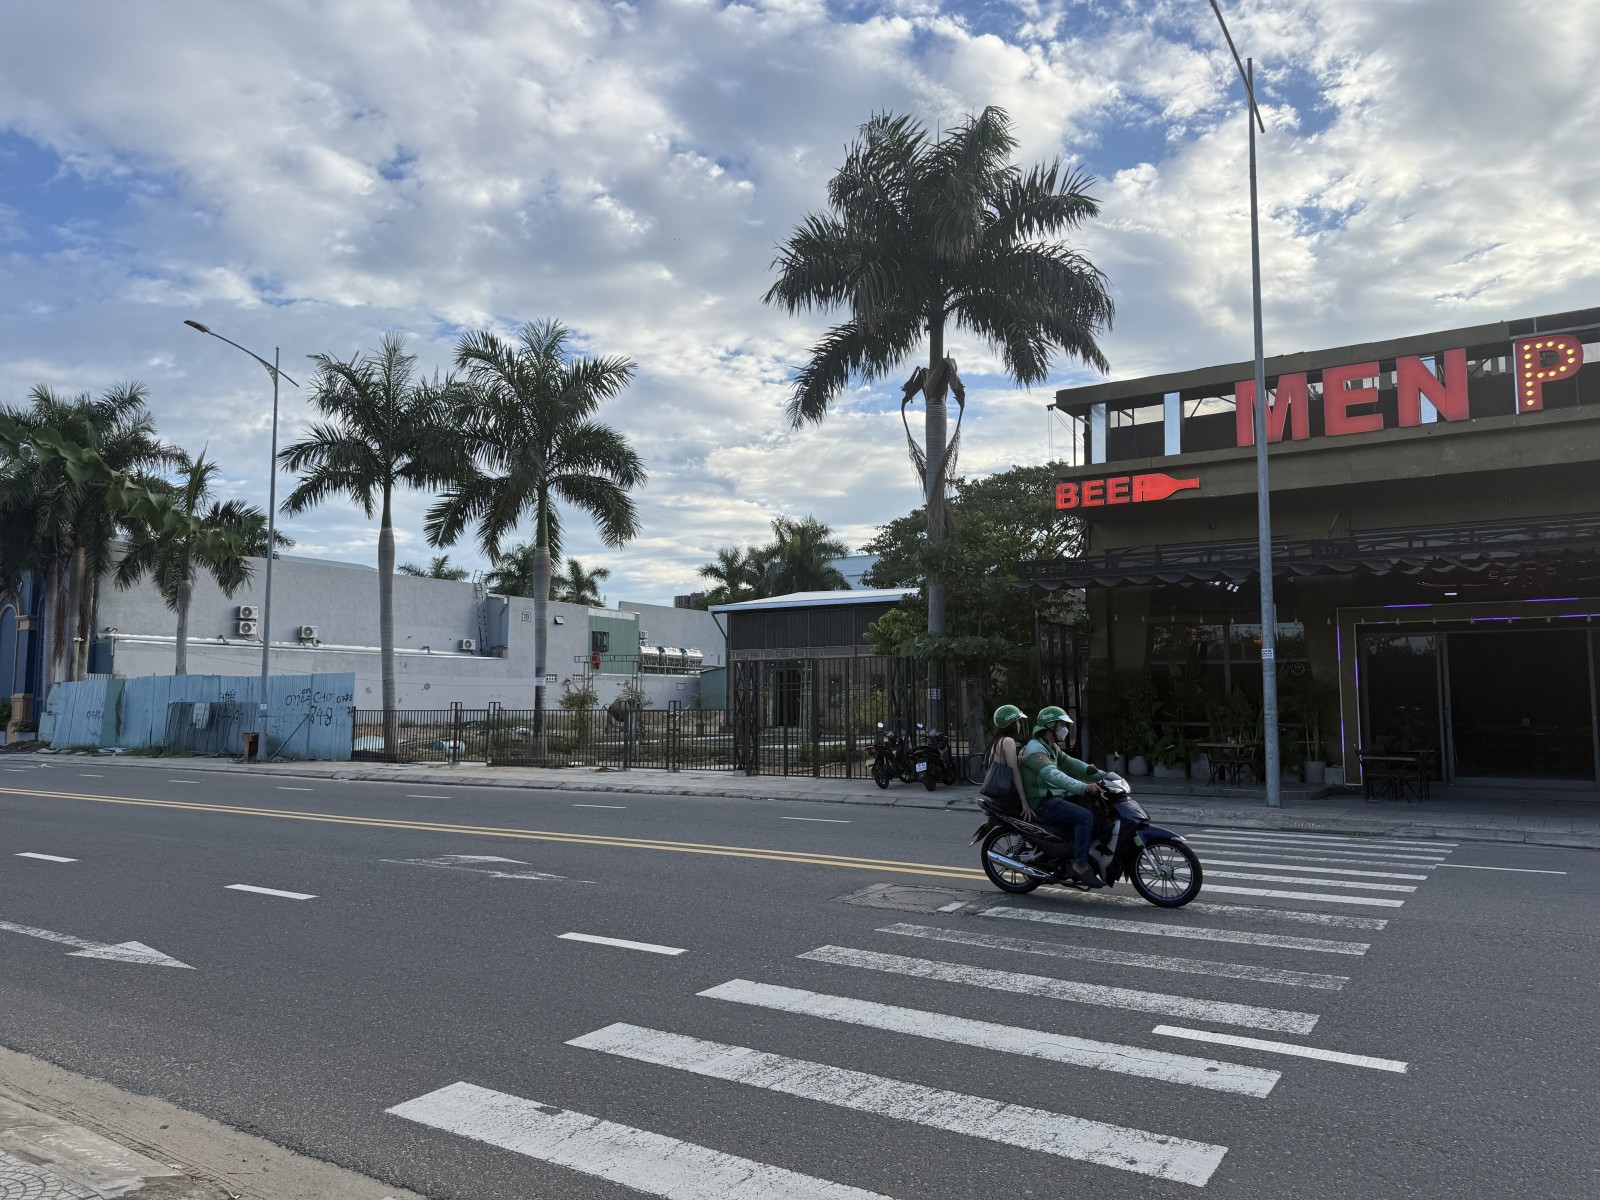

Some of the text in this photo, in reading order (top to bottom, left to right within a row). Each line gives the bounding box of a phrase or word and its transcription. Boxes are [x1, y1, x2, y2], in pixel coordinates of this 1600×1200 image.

[1235, 334, 1584, 448] MEN P
[1004, 713, 1017, 721] Grab
